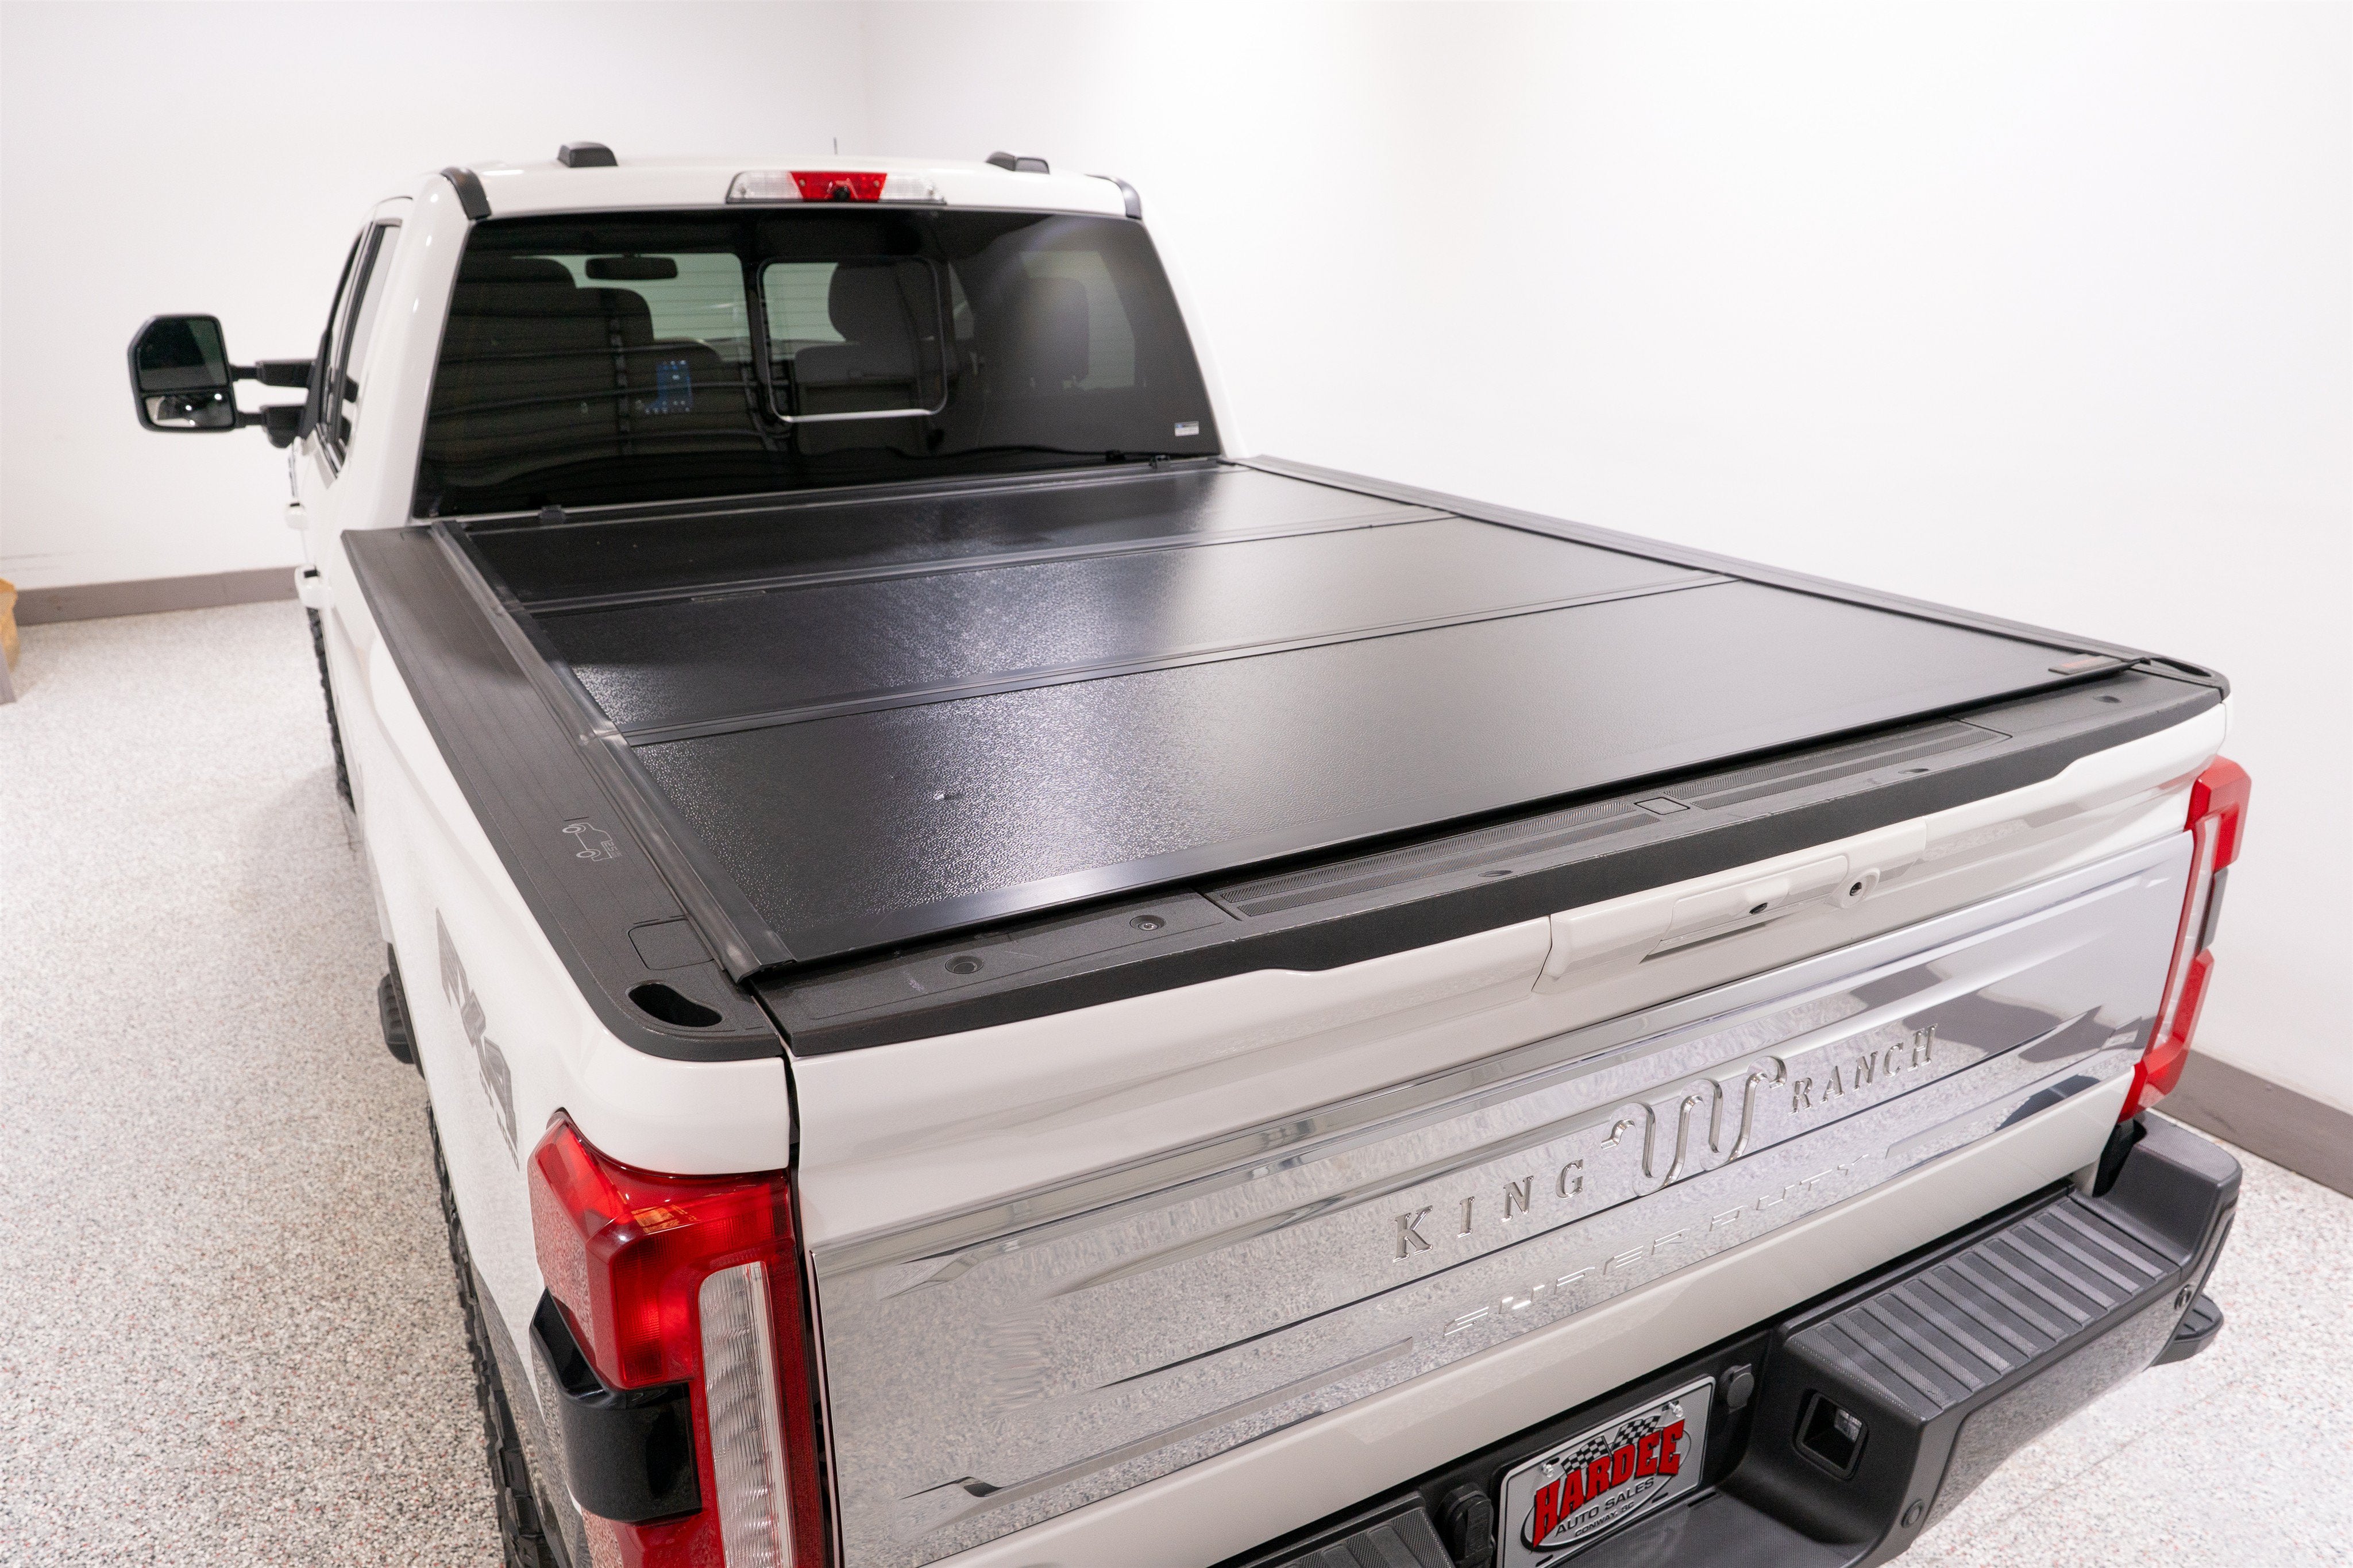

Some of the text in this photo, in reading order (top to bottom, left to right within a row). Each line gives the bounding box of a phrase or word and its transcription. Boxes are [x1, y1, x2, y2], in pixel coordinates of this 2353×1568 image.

[435, 907, 518, 1149] FX4
[479, 1069, 520, 1172] OFF ROAD
[1392, 1022, 1938, 1263] KING RANCH
[1442, 1153, 1869, 1339] SUPER DUTY
[1532, 1418, 1685, 1549] HARDEE
[1554, 1477, 1654, 1538] AUTO SALES
[1621, 1500, 1635, 1513] SC
